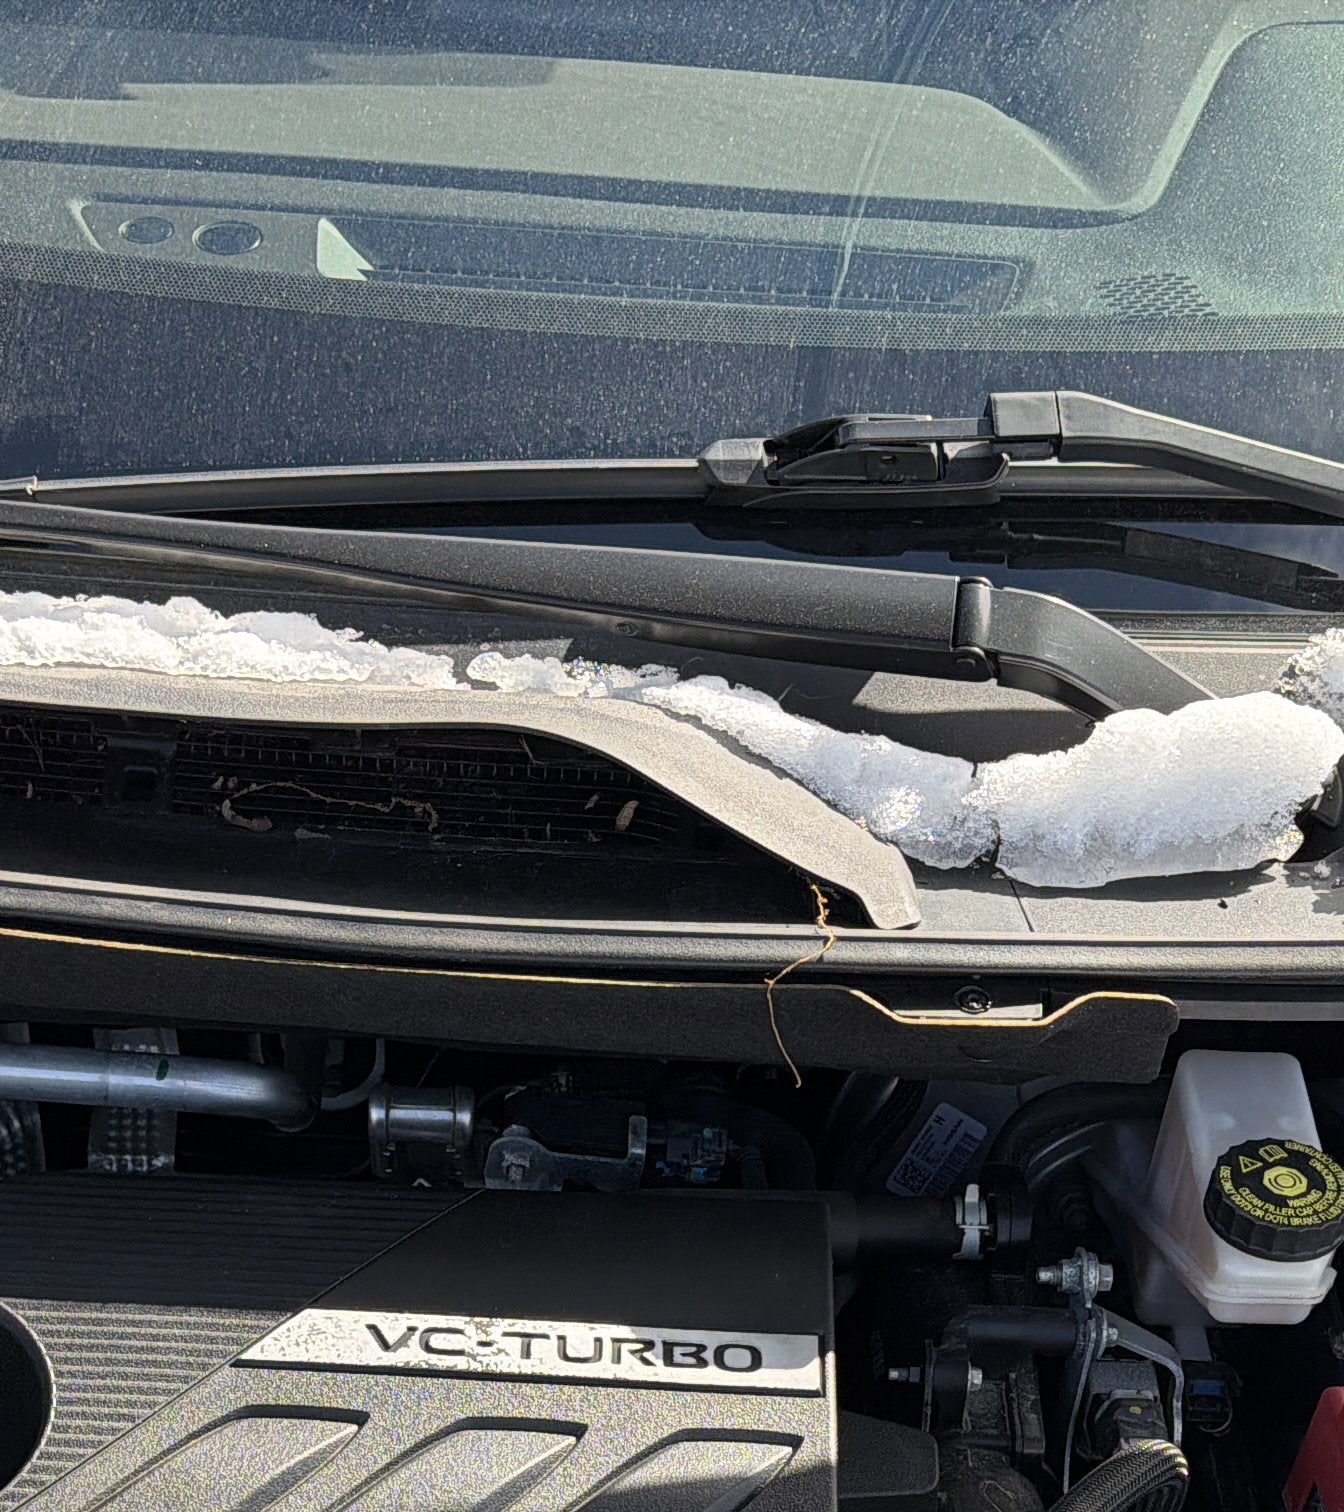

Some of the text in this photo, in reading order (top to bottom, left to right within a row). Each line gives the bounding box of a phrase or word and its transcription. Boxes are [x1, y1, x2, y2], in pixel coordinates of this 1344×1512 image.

[1285, 1141, 1332, 1164] CONTAINER
[1238, 1159, 1337, 1217] CLEAN FILLER CAP BEFORE REMOVING
[1230, 1194, 1252, 1211] DOT3
[1287, 1189, 1322, 1208] WARNING
[1250, 1208, 1264, 1218] OR
[1265, 1213, 1288, 1224] DOT4
[1290, 1216, 1321, 1226] BRAKE
[1321, 1206, 1341, 1221] FLUID
[365, 1323, 763, 1373] VC-TURBO
